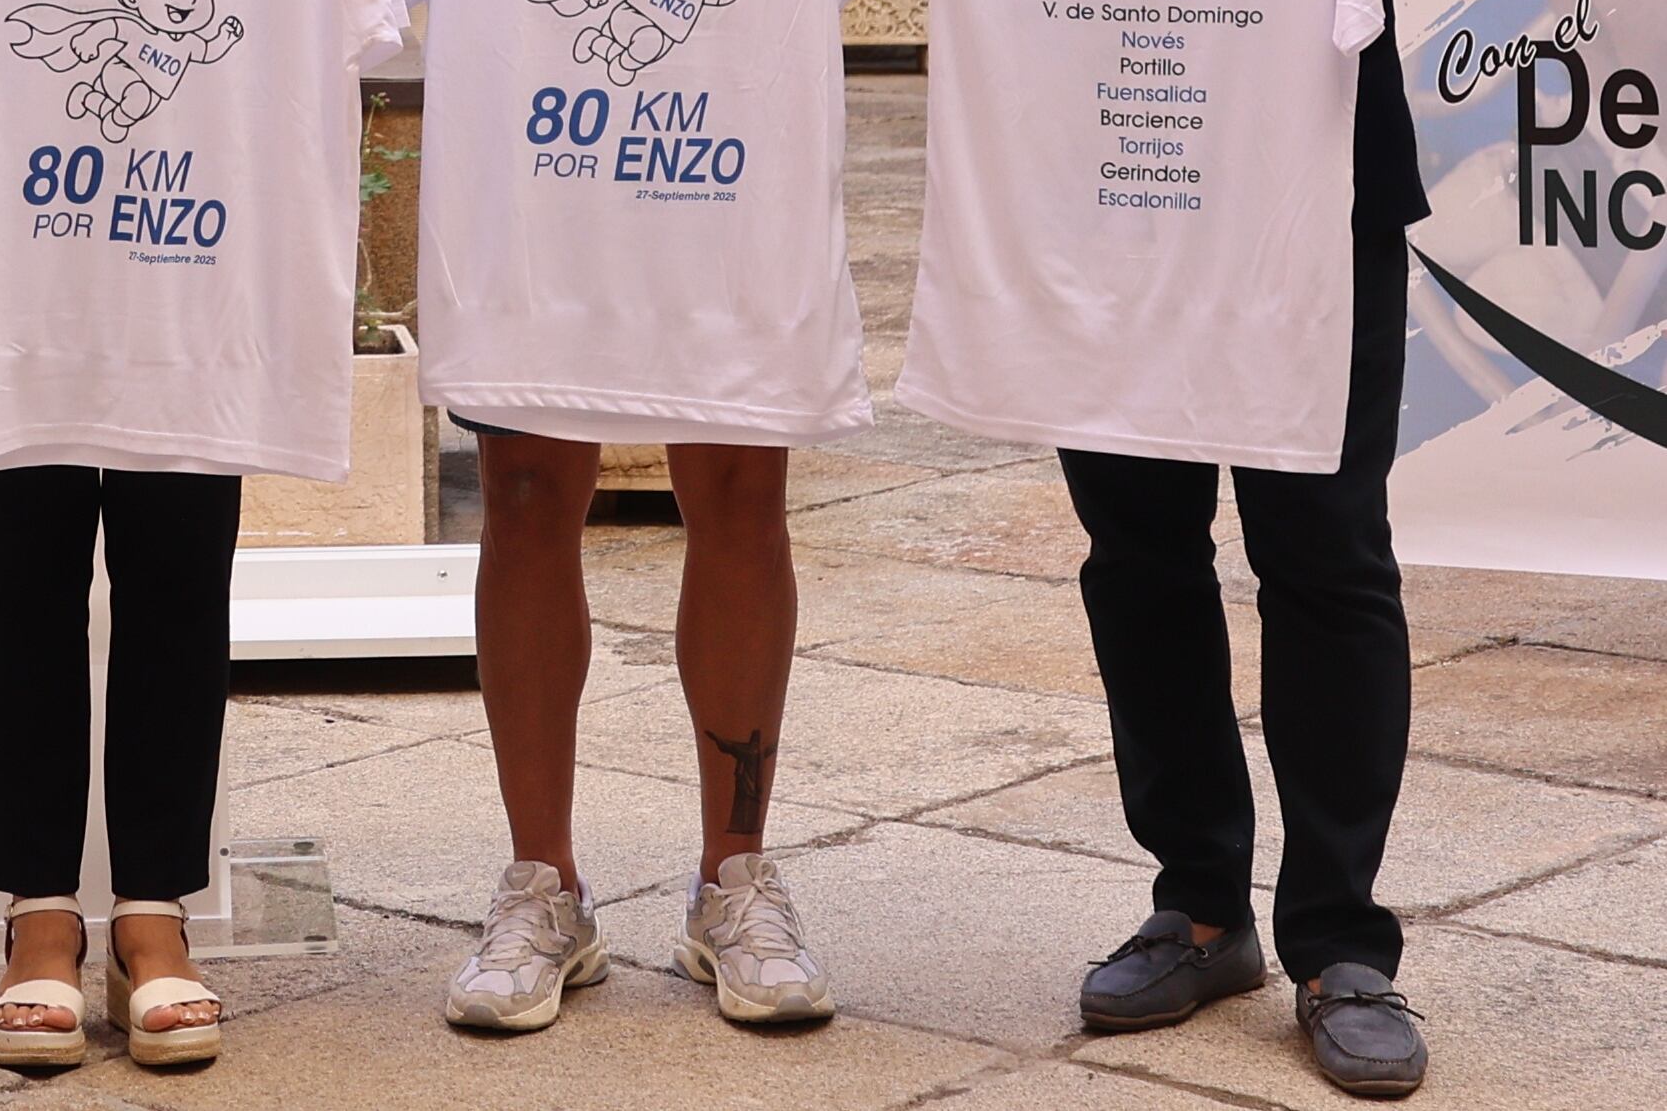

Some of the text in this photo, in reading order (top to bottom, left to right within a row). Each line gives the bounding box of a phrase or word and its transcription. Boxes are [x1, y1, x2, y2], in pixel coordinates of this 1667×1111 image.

[1043, 1, 1263, 28] V. de Santo Domingo
[1121, 31, 1184, 49] Novés
[138, 44, 180, 76] ENZO
[1120, 57, 1185, 76] Portillo
[1438, 27, 1536, 104] Con
[1097, 83, 1206, 103] Fuensalida
[526, 87, 708, 146] 80 KM
[1101, 109, 1203, 129] Barcience
[1119, 137, 1183, 158] Torrijos
[534, 136, 745, 185] POR ENZO
[23, 146, 193, 205] 80 KM
[1101, 162, 1200, 183] Gerindote
[636, 190, 736, 202] 27-Septiembre 2025
[1099, 188, 1201, 210] Escalonilla
[33, 195, 226, 247] POR ENZO
[194, 255, 216, 265] 2025
